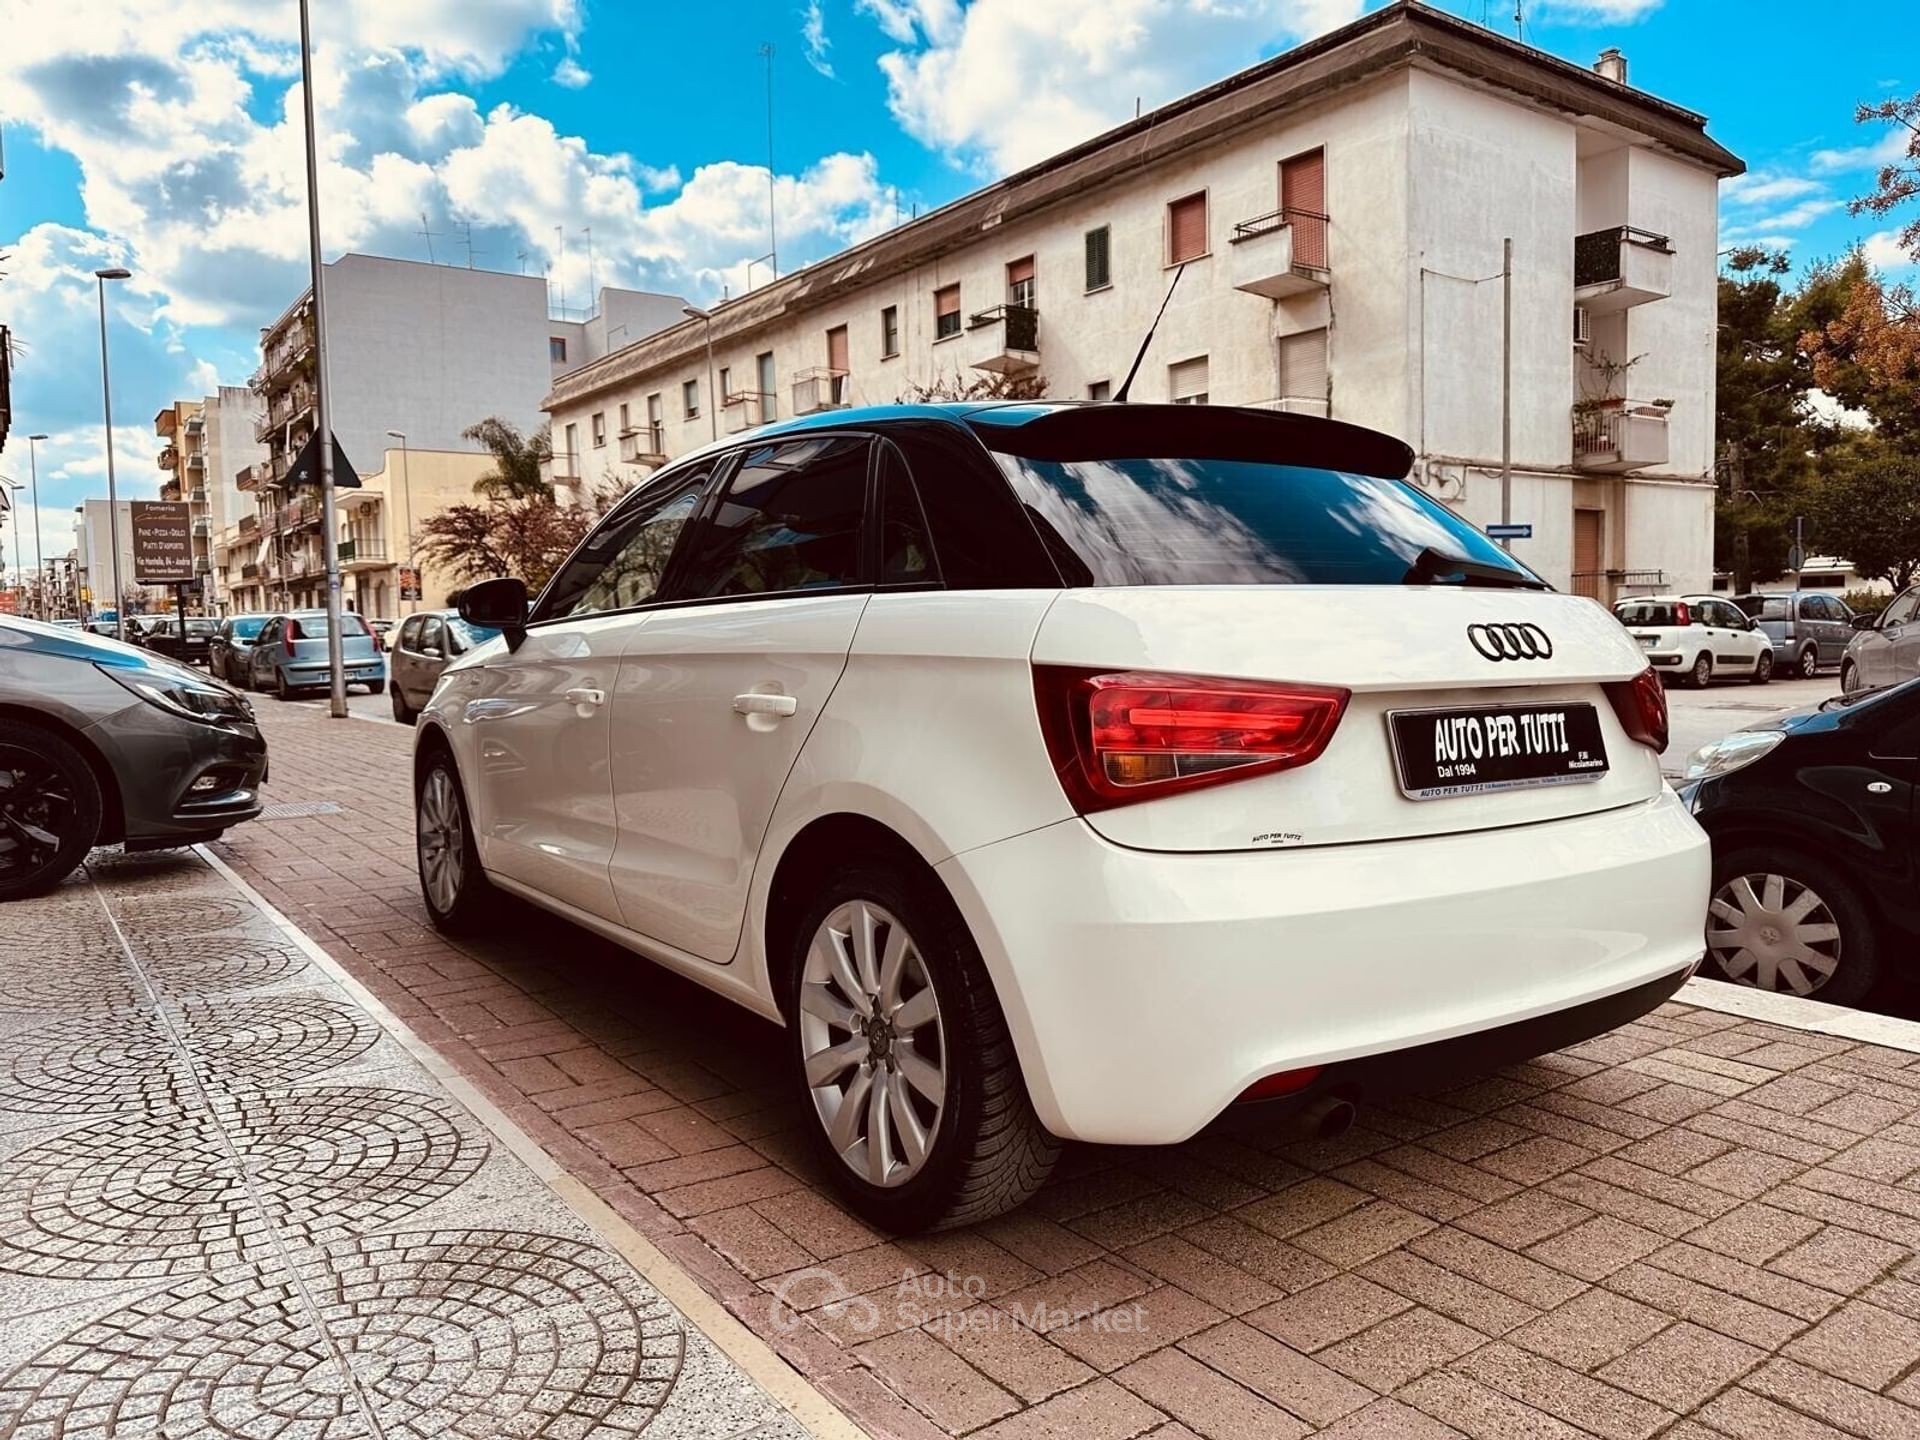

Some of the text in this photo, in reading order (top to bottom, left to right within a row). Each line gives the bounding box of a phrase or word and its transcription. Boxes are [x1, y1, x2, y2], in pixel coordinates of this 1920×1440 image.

[1435, 712, 1569, 763] AUTO PER TUTTI
[1437, 763, 1476, 778] Dal 1994
[1420, 784, 1483, 797] AUTO PER TUTTI
